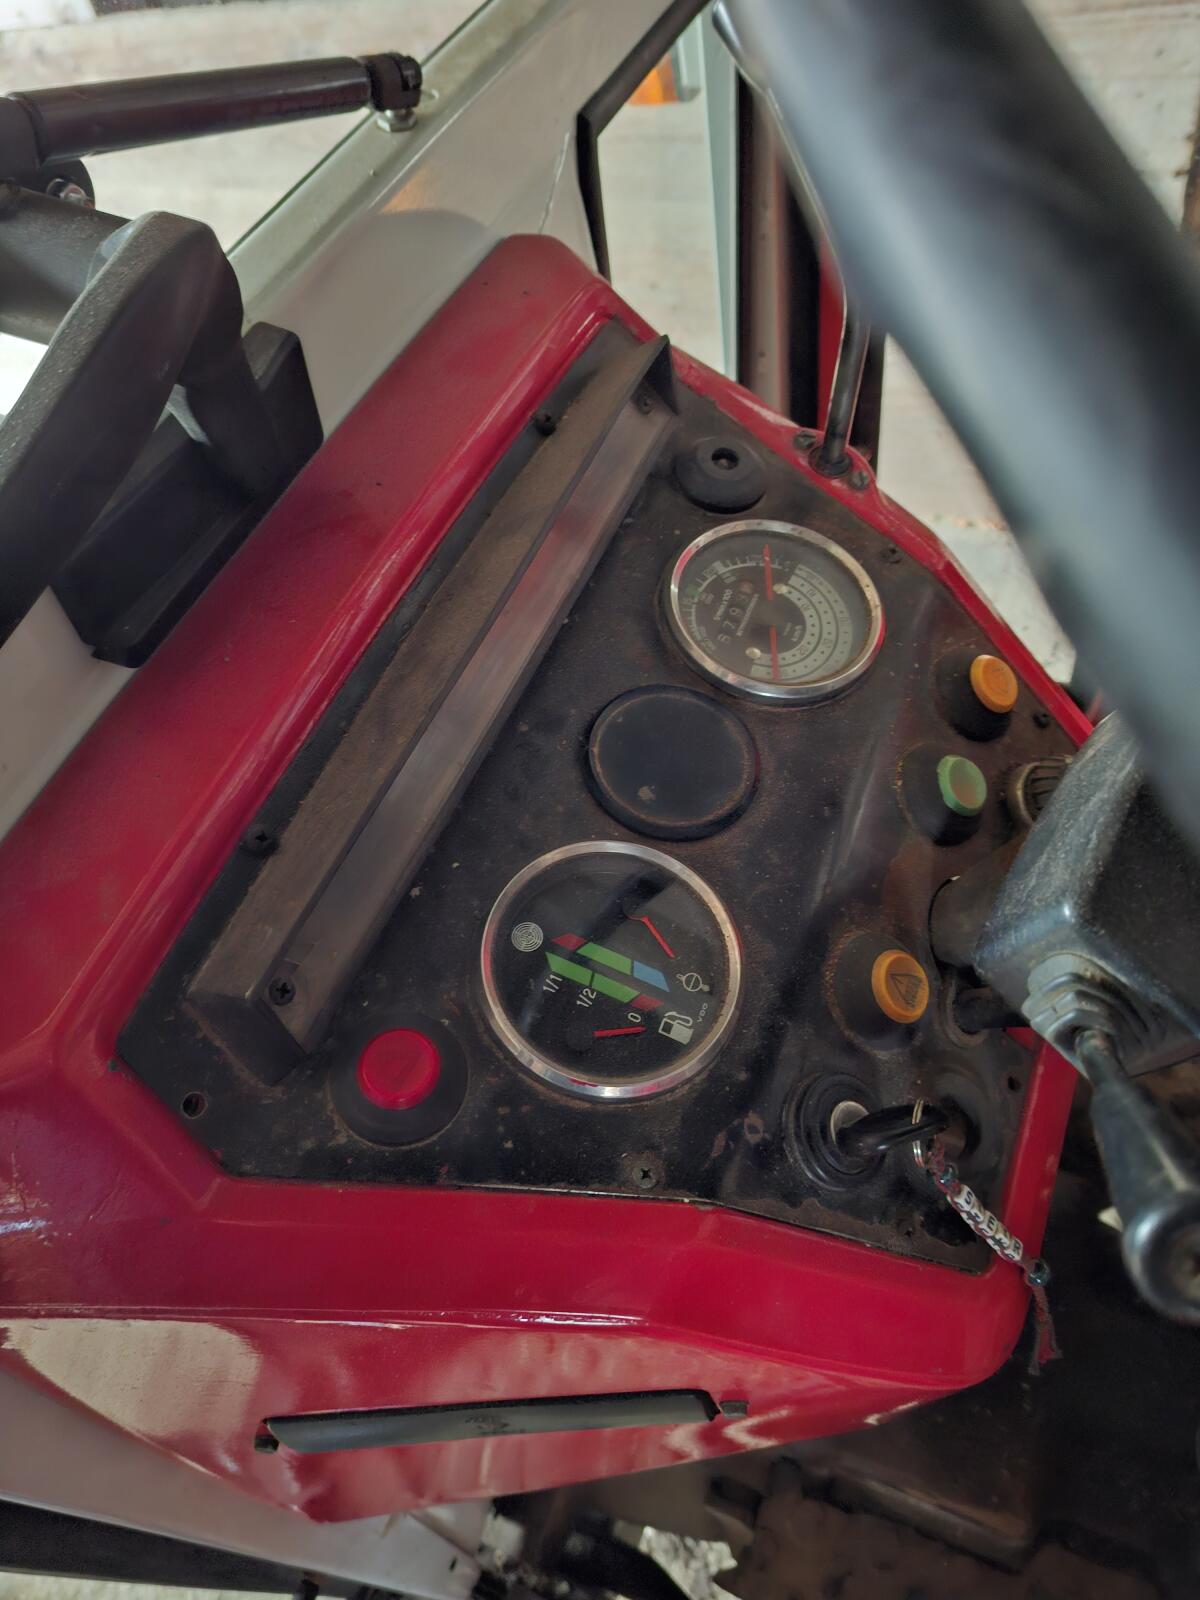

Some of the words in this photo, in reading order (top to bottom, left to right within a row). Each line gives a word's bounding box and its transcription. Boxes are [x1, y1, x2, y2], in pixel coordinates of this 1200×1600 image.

[543, 974, 563, 993] 1/1
[576, 988, 597, 1008] 1/2
[627, 1012, 642, 1024] 0
